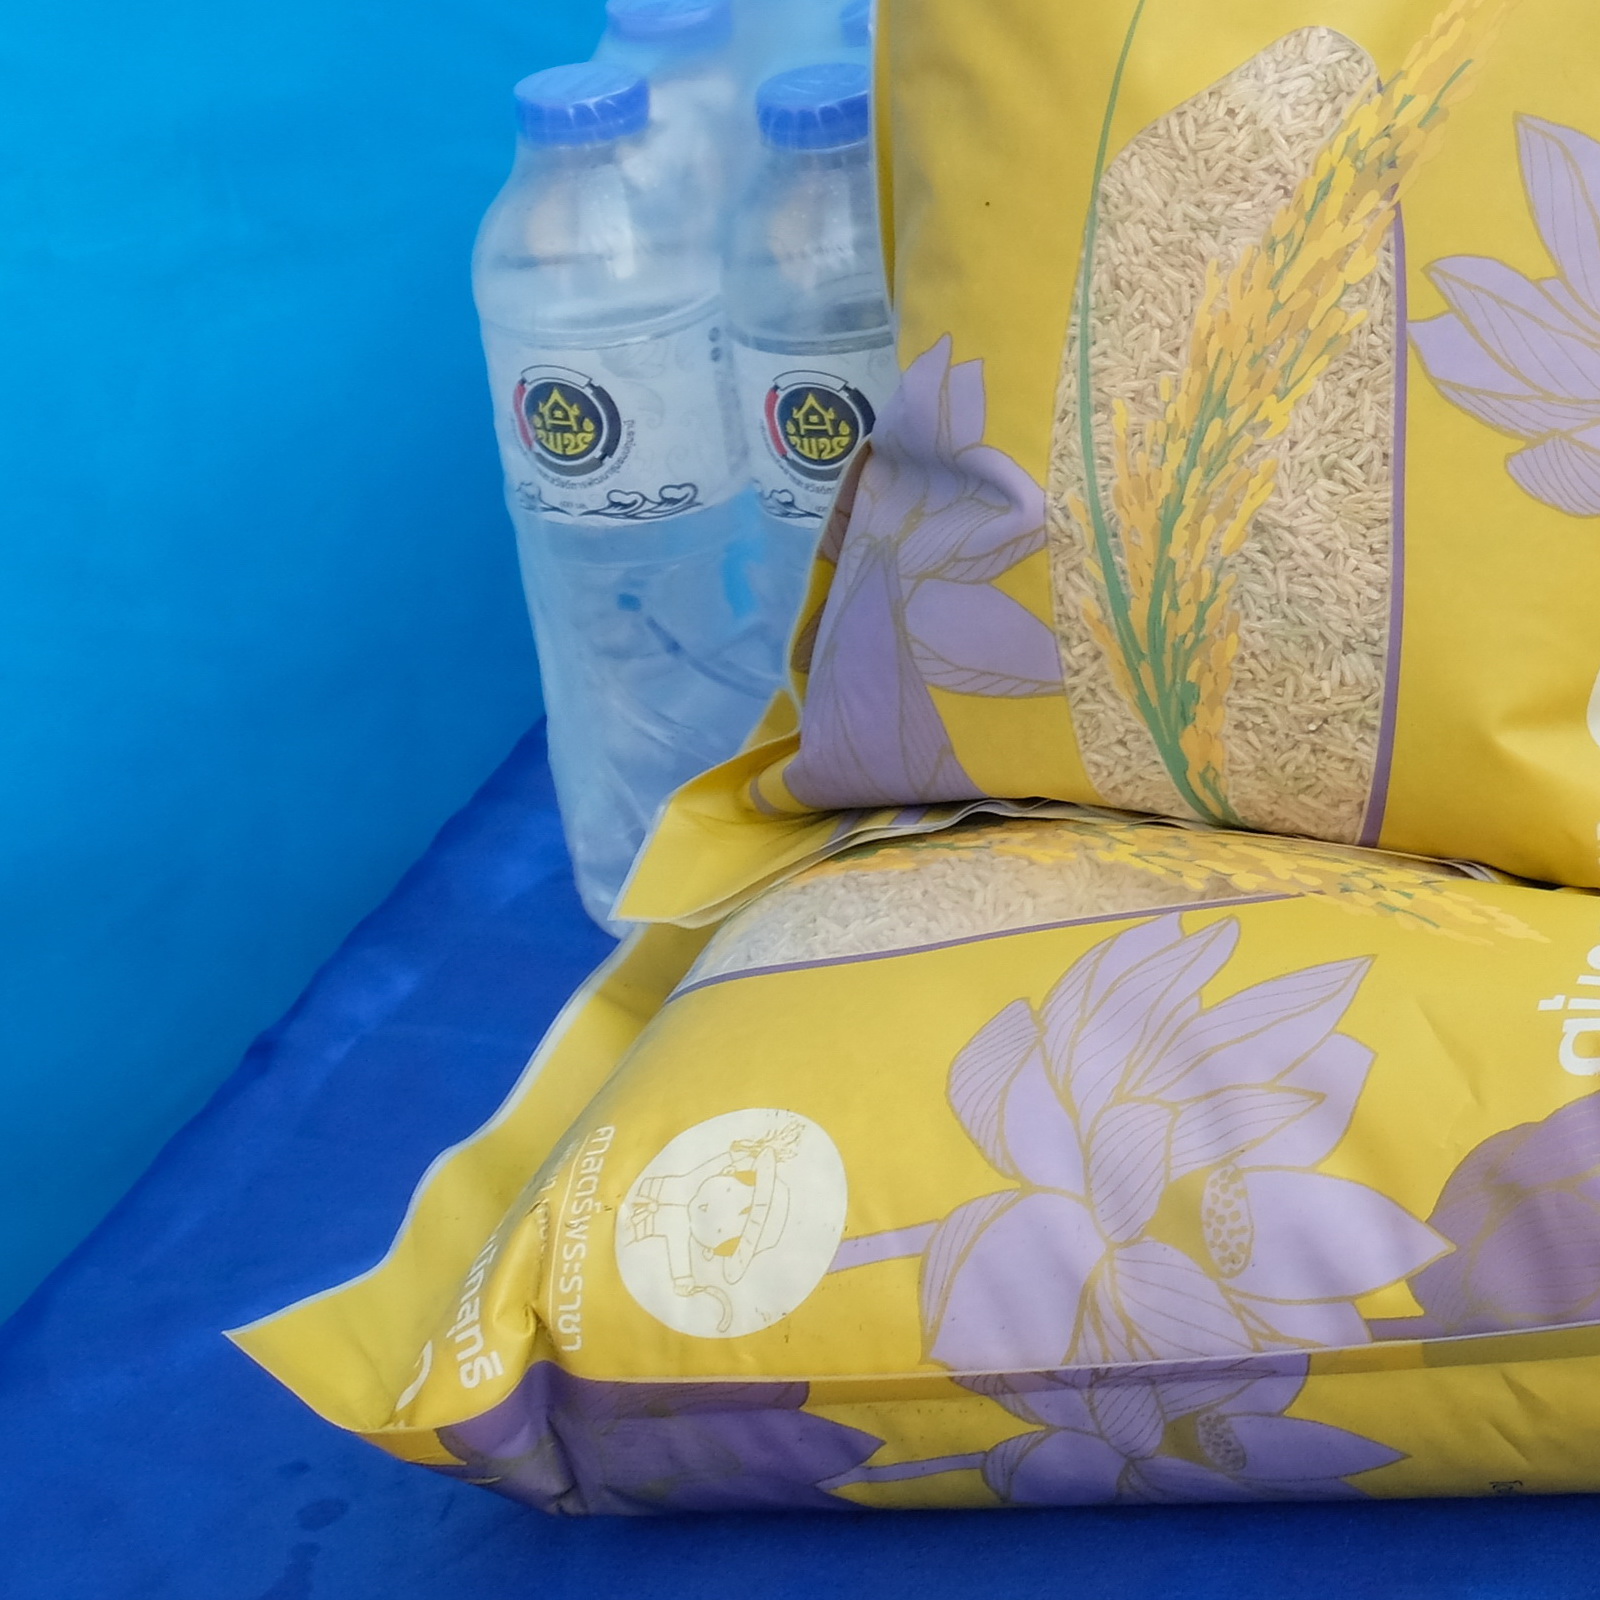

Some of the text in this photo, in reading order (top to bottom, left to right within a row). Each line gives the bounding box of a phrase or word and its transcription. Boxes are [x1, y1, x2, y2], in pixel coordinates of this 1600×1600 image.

[559, 1124, 617, 1353] ศาสตร์พระราชา
